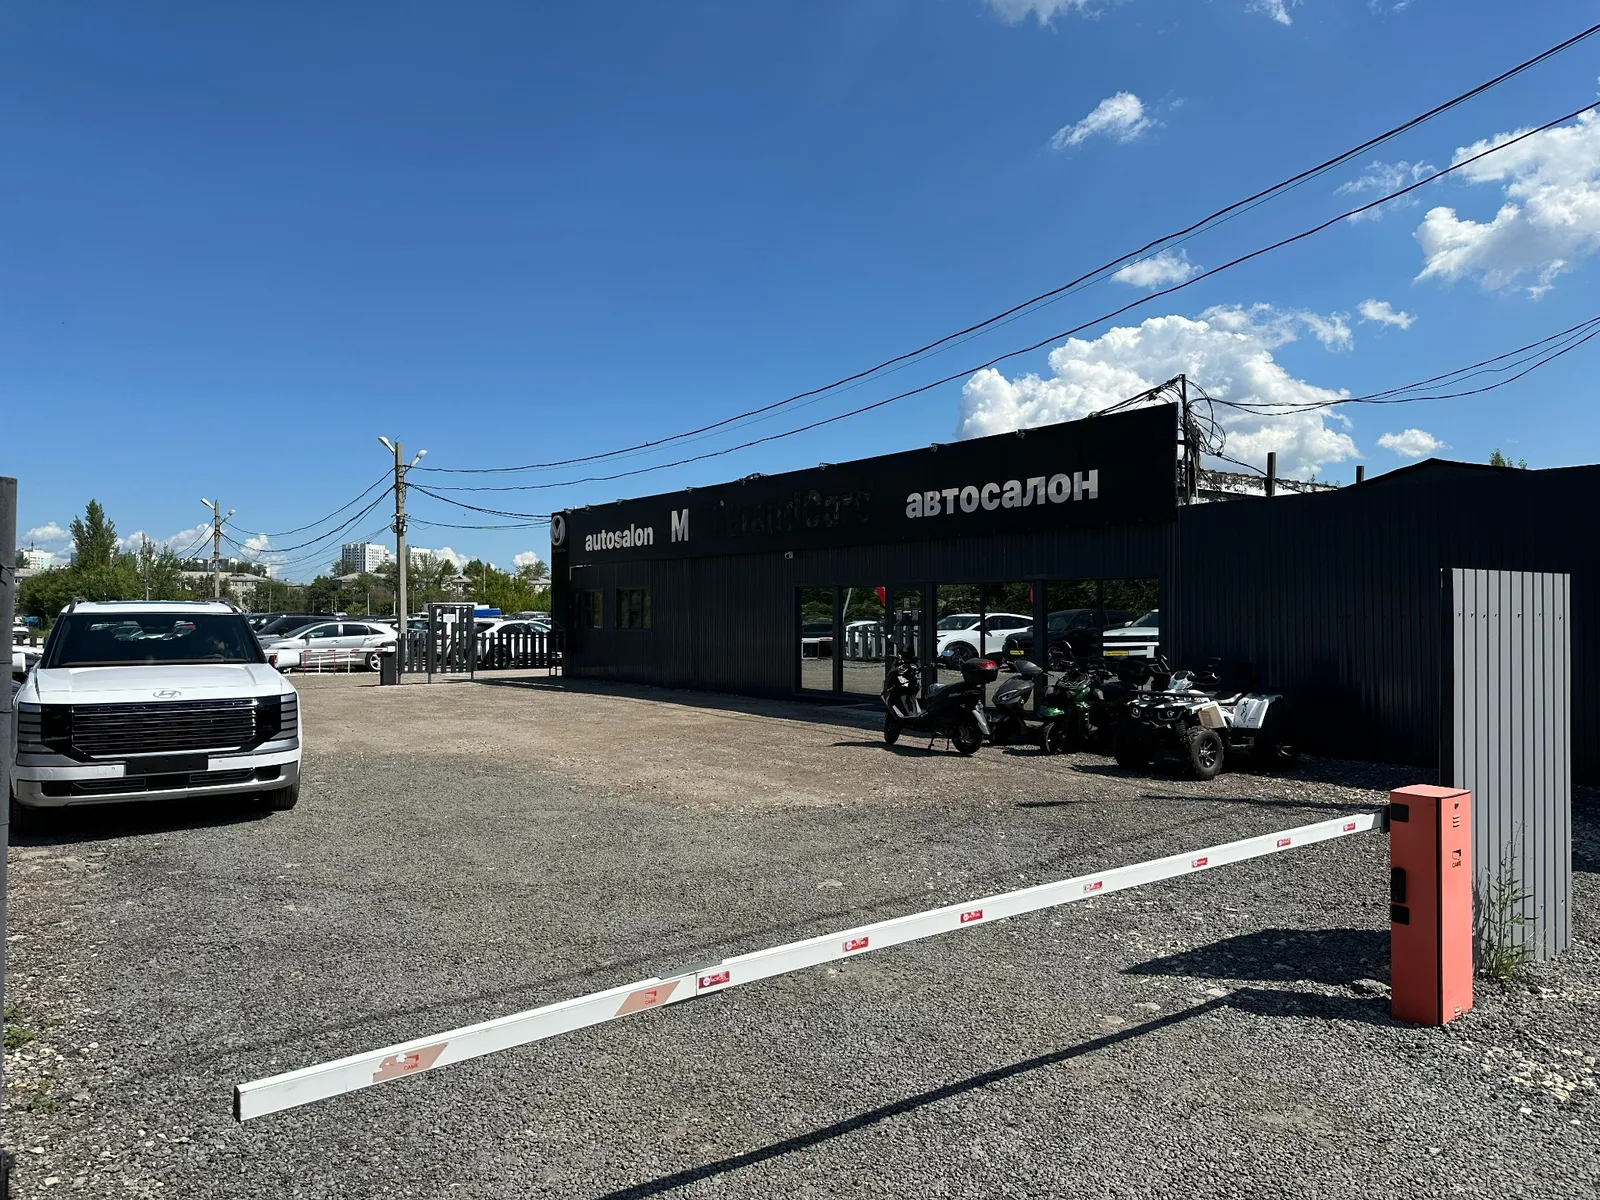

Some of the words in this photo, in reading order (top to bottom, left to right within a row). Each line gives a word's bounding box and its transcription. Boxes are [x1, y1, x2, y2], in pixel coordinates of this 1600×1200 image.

[905, 468, 1099, 519] автосалон
[585, 523, 654, 552] autosalon
[671, 508, 689, 543] M
[404, 1063, 419, 1071] CAME
